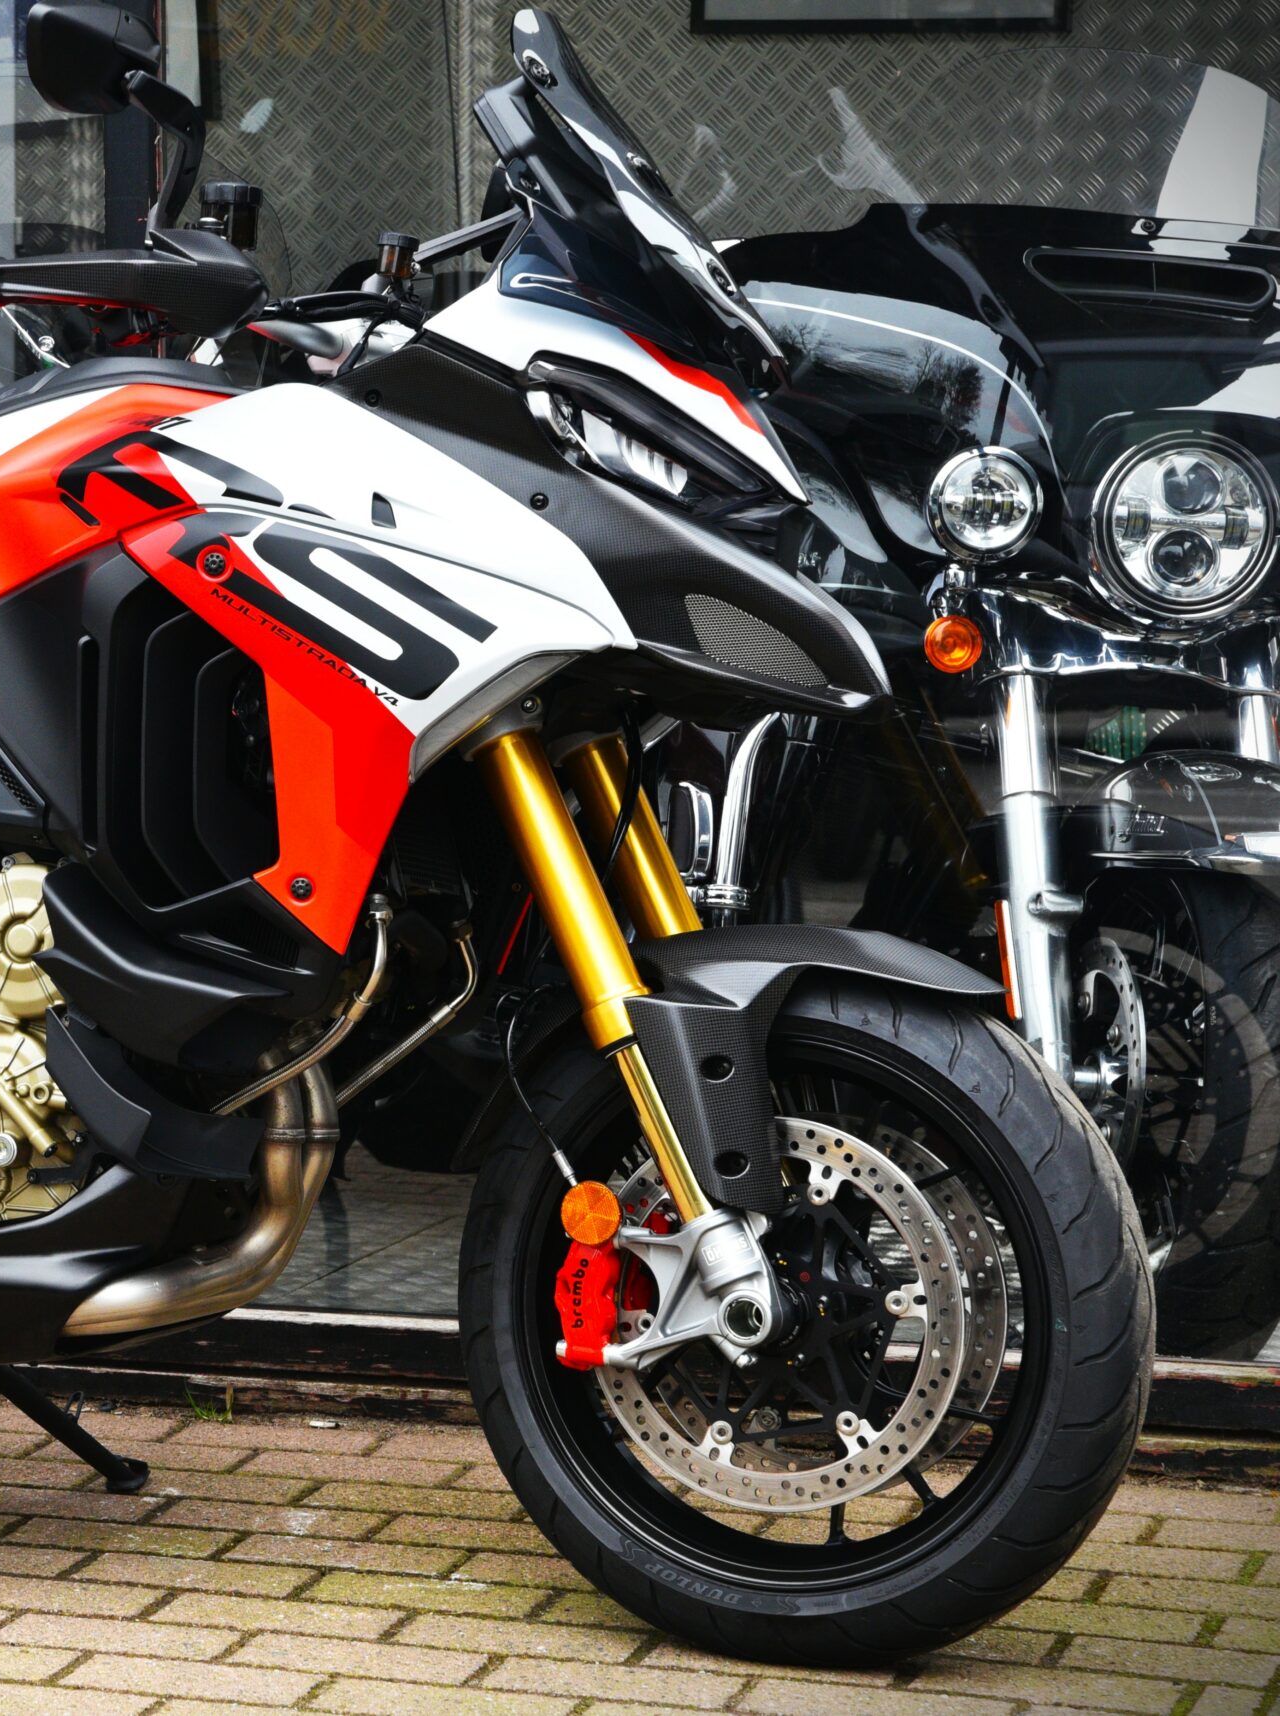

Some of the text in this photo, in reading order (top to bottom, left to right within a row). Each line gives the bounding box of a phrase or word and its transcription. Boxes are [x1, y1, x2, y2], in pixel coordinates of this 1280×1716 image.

[211, 588, 399, 707] MULTISTRADA V4
[705, 1236, 748, 1262] ÖHS
[571, 1257, 589, 1329] brembo
[644, 1562, 744, 1605] DUNLOP
